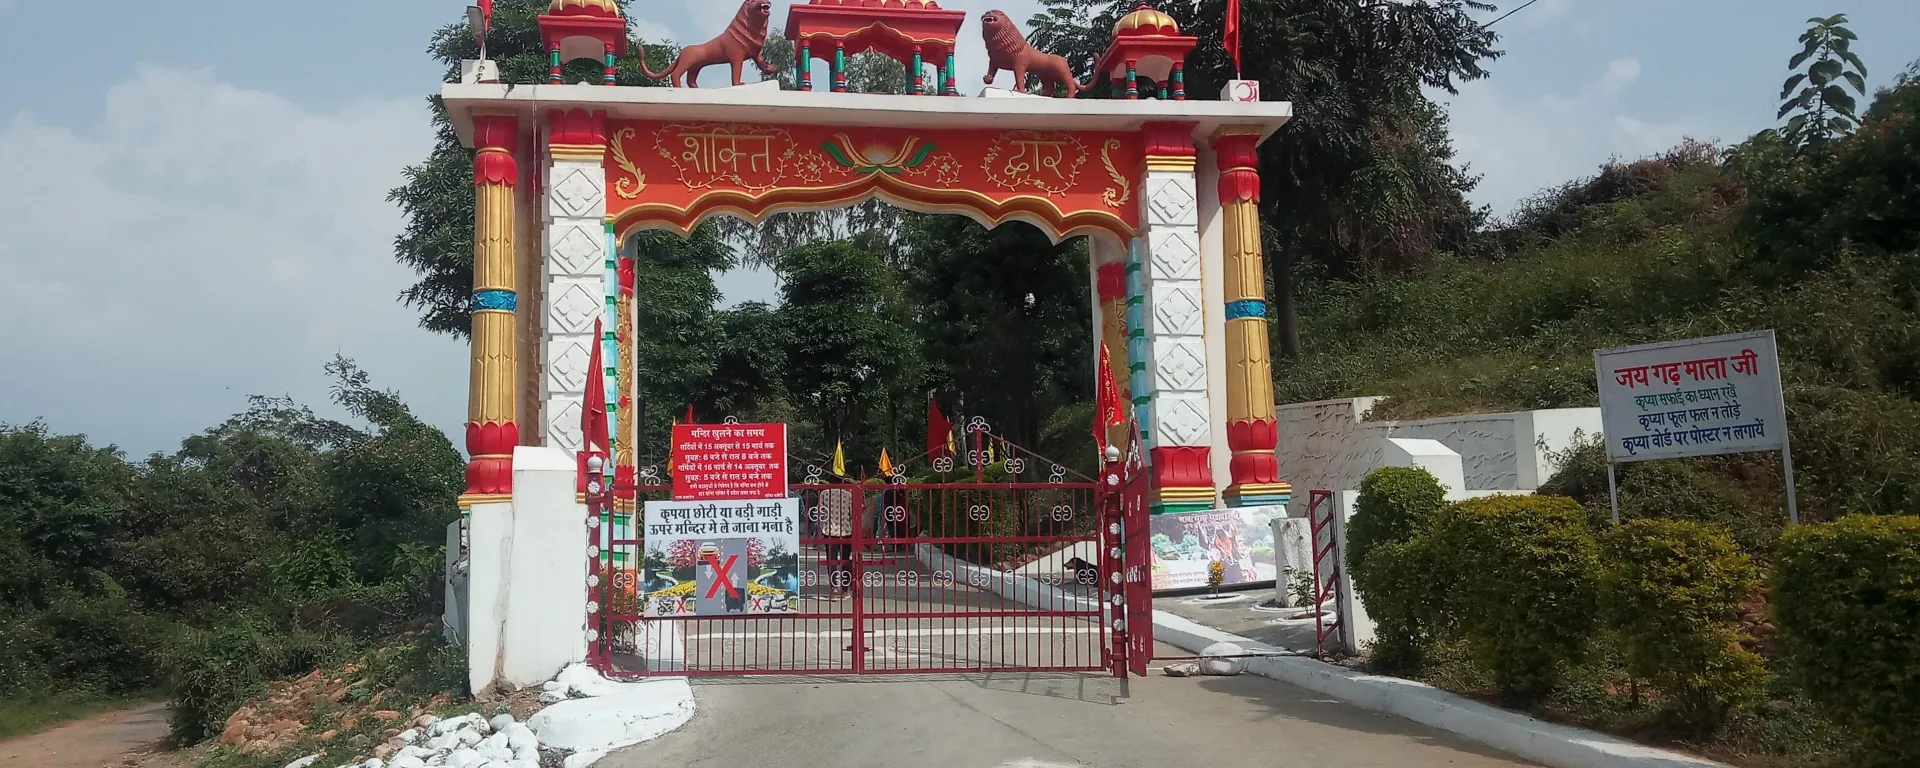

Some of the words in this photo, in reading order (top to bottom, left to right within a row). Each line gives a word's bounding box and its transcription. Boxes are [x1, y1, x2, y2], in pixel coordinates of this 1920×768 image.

[677, 127, 775, 174] शक्ति
[1004, 140, 1067, 180] द्वार
[1614, 366, 1649, 388] जय
[1651, 362, 1681, 386] गढ़
[1683, 357, 1727, 381] माता
[1730, 349, 1758, 376] जी
[1658, 388, 1684, 406] सफाई
[1685, 391, 1698, 403] का
[1698, 388, 1720, 401] ध्यान
[1721, 383, 1737, 399] रखें
[1667, 410, 1687, 428] फूल
[1689, 407, 1709, 422] फल
[1711, 407, 1719, 419] न
[691, 428, 710, 438] मन्दिर
[712, 427, 732, 440] खुलने
[733, 429, 744, 437] का
[746, 429, 765, 437] समय
[1673, 431, 1689, 446] पर
[1690, 425, 1721, 444] पोस्टर
[1722, 430, 1731, 442] न
[1733, 418, 1765, 440] लगायें
[735, 441, 740, 449] से
[721, 452, 727, 460] से
[726, 462, 732, 470] से
[721, 472, 727, 480] से
[660, 508, 690, 523] कृपया
[693, 504, 717, 518] छोटी
[720, 506, 732, 518] या
[757, 502, 782, 520] गाड़ी
[649, 522, 672, 535] ऊपर
[675, 519, 706, 534] मन्दिर
[720, 519, 729, 533] ले
[732, 521, 759, 533] जाना
[761, 520, 783, 533] मना
[785, 517, 793, 534] है
